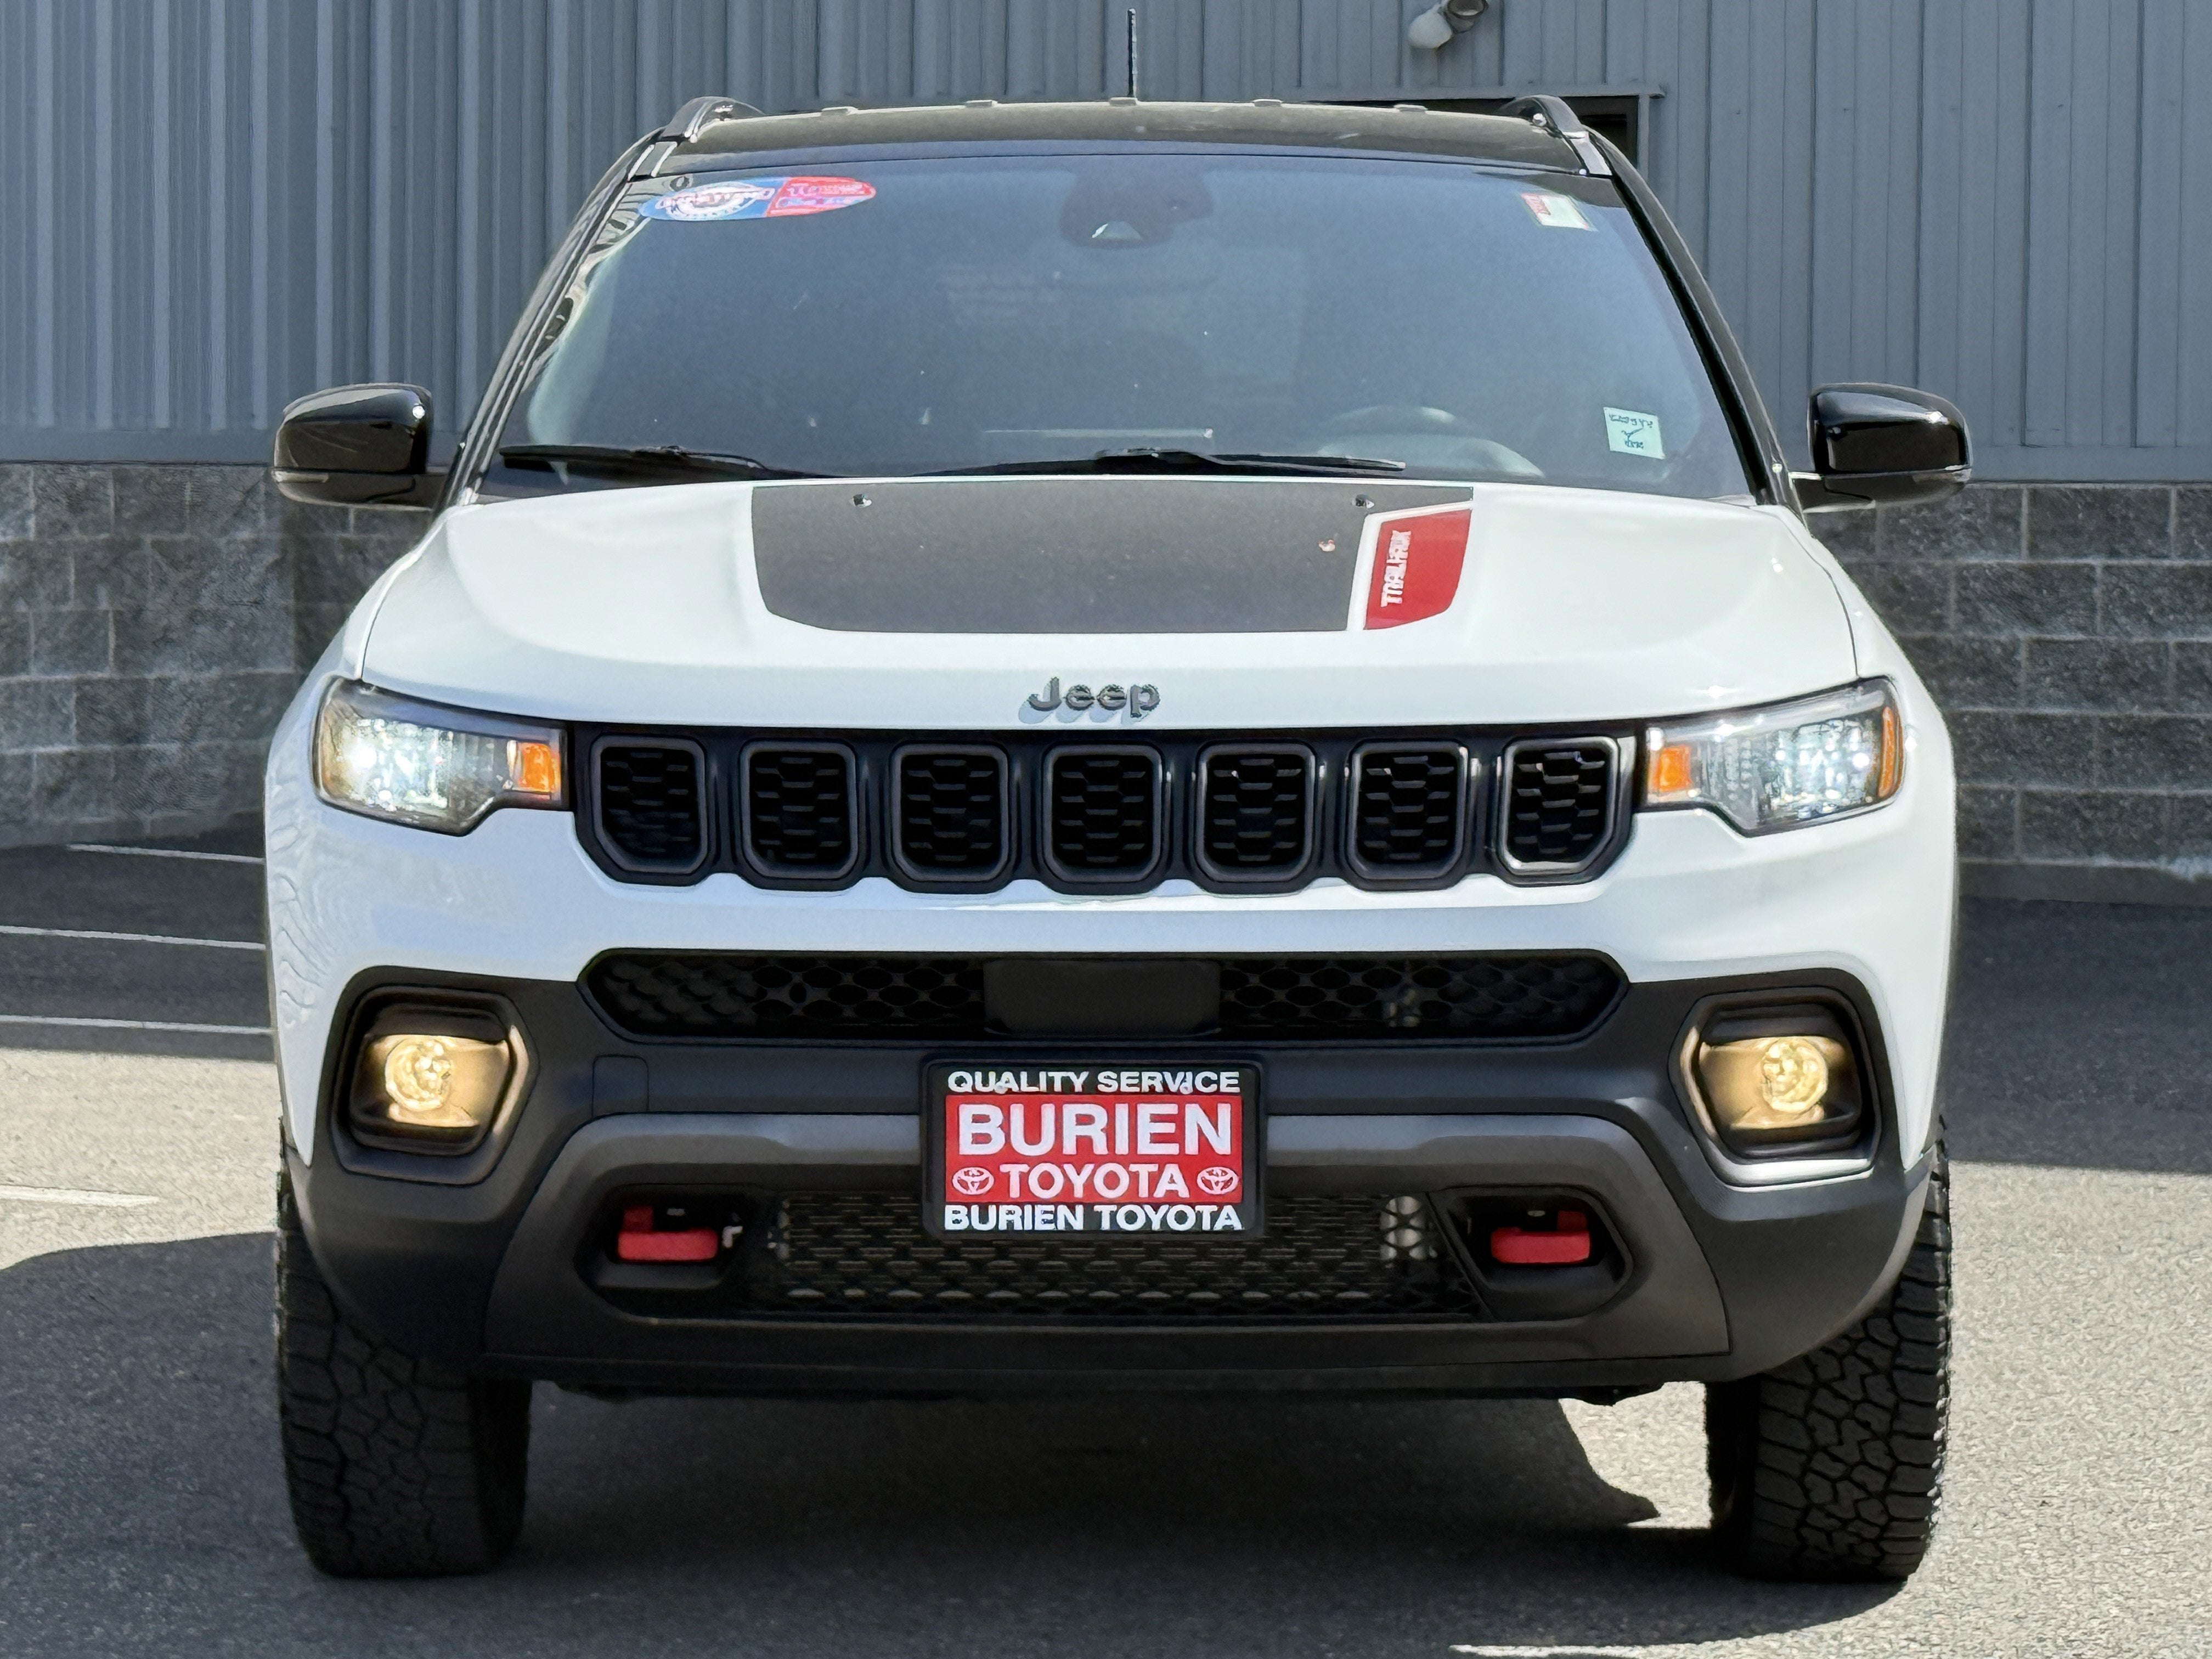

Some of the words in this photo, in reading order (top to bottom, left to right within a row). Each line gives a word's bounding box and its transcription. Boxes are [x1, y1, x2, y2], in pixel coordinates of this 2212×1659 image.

[1026, 676, 1161, 718] Jeep
[947, 1071, 1089, 1094] QUALITY
[1097, 1071, 1240, 1094] SERVICE
[958, 1103, 1231, 1156] BURIEN
[999, 1163, 1190, 1199] TOYOTA
[944, 1204, 1084, 1231] BURIEN
[1093, 1204, 1244, 1231] TOYOTA
